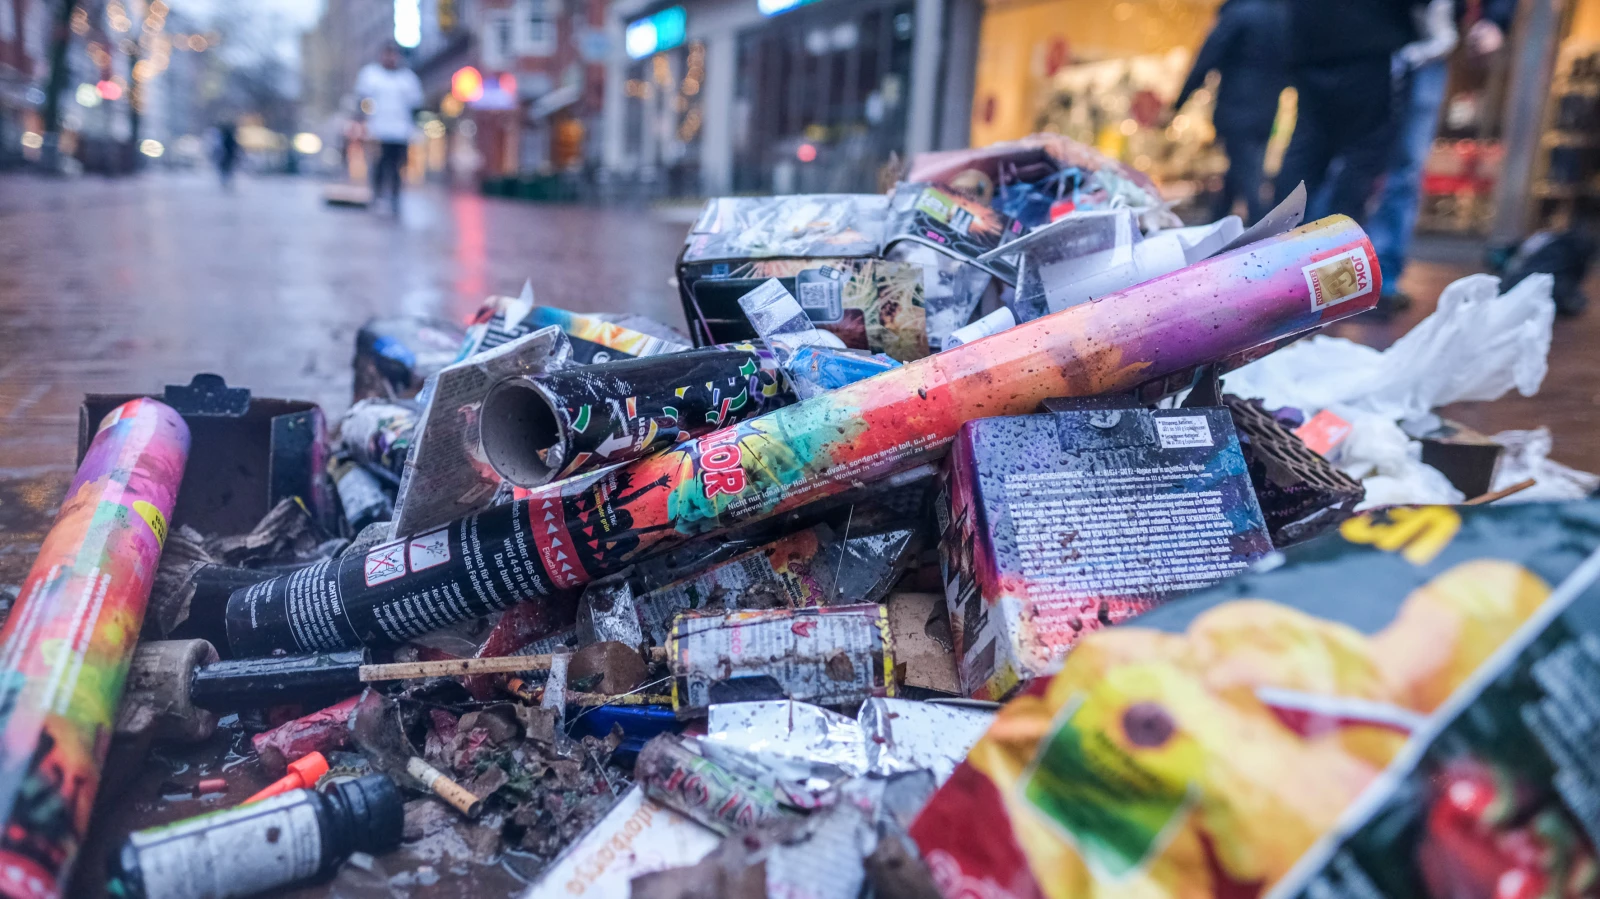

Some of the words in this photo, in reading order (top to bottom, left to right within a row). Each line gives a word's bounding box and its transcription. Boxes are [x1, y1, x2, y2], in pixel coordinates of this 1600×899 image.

[1351, 255, 1367, 291] JOKA
[1309, 270, 1323, 306] EDITION
[633, 416, 646, 452] oben
[727, 497, 747, 510] Nicht
[748, 494, 761, 502] nur
[762, 486, 780, 498] ideal
[780, 483, 792, 493] für
[792, 477, 807, 488] Holi
[849, 453, 878, 467] sondern
[898, 441, 913, 451] toll,
[927, 433, 936, 441] an
[730, 503, 762, 518] Karneval
[781, 485, 811, 500] Silvester
[834, 466, 861, 481] Wolken
[914, 446, 923, 454] zu
[513, 518, 520, 531] am
[596, 504, 604, 517] oder
[600, 518, 610, 532] grün
[460, 539, 470, 555] und
[470, 525, 487, 569] ungefährlich
[502, 537, 515, 558] wird
[514, 531, 528, 559] Boden
[463, 554, 474, 570] das
[479, 567, 490, 580] für
[493, 552, 505, 569] Der
[499, 568, 516, 590] bunte
[509, 557, 521, 573] 4-6
[523, 558, 535, 575] des
[467, 569, 489, 604] Farbpulver
[483, 579, 502, 602] Mensch
[515, 573, 524, 582] m
[519, 580, 529, 589] in
[319, 590, 329, 610] Aufsicht
[324, 610, 332, 620] und
[328, 579, 341, 615] ACHTUNG!
[392, 600, 407, 622] Niemals
[421, 590, 436, 613] Niemals
[440, 584, 460, 614] Funktioniert
[304, 592, 316, 623] Innenräumen
[312, 623, 321, 634] oder
[313, 601, 326, 627] Menschen
[321, 625, 331, 637] oder
[372, 606, 381, 619] Nur
[382, 603, 400, 631] Empfohlen
[731, 621, 742, 655] eco
